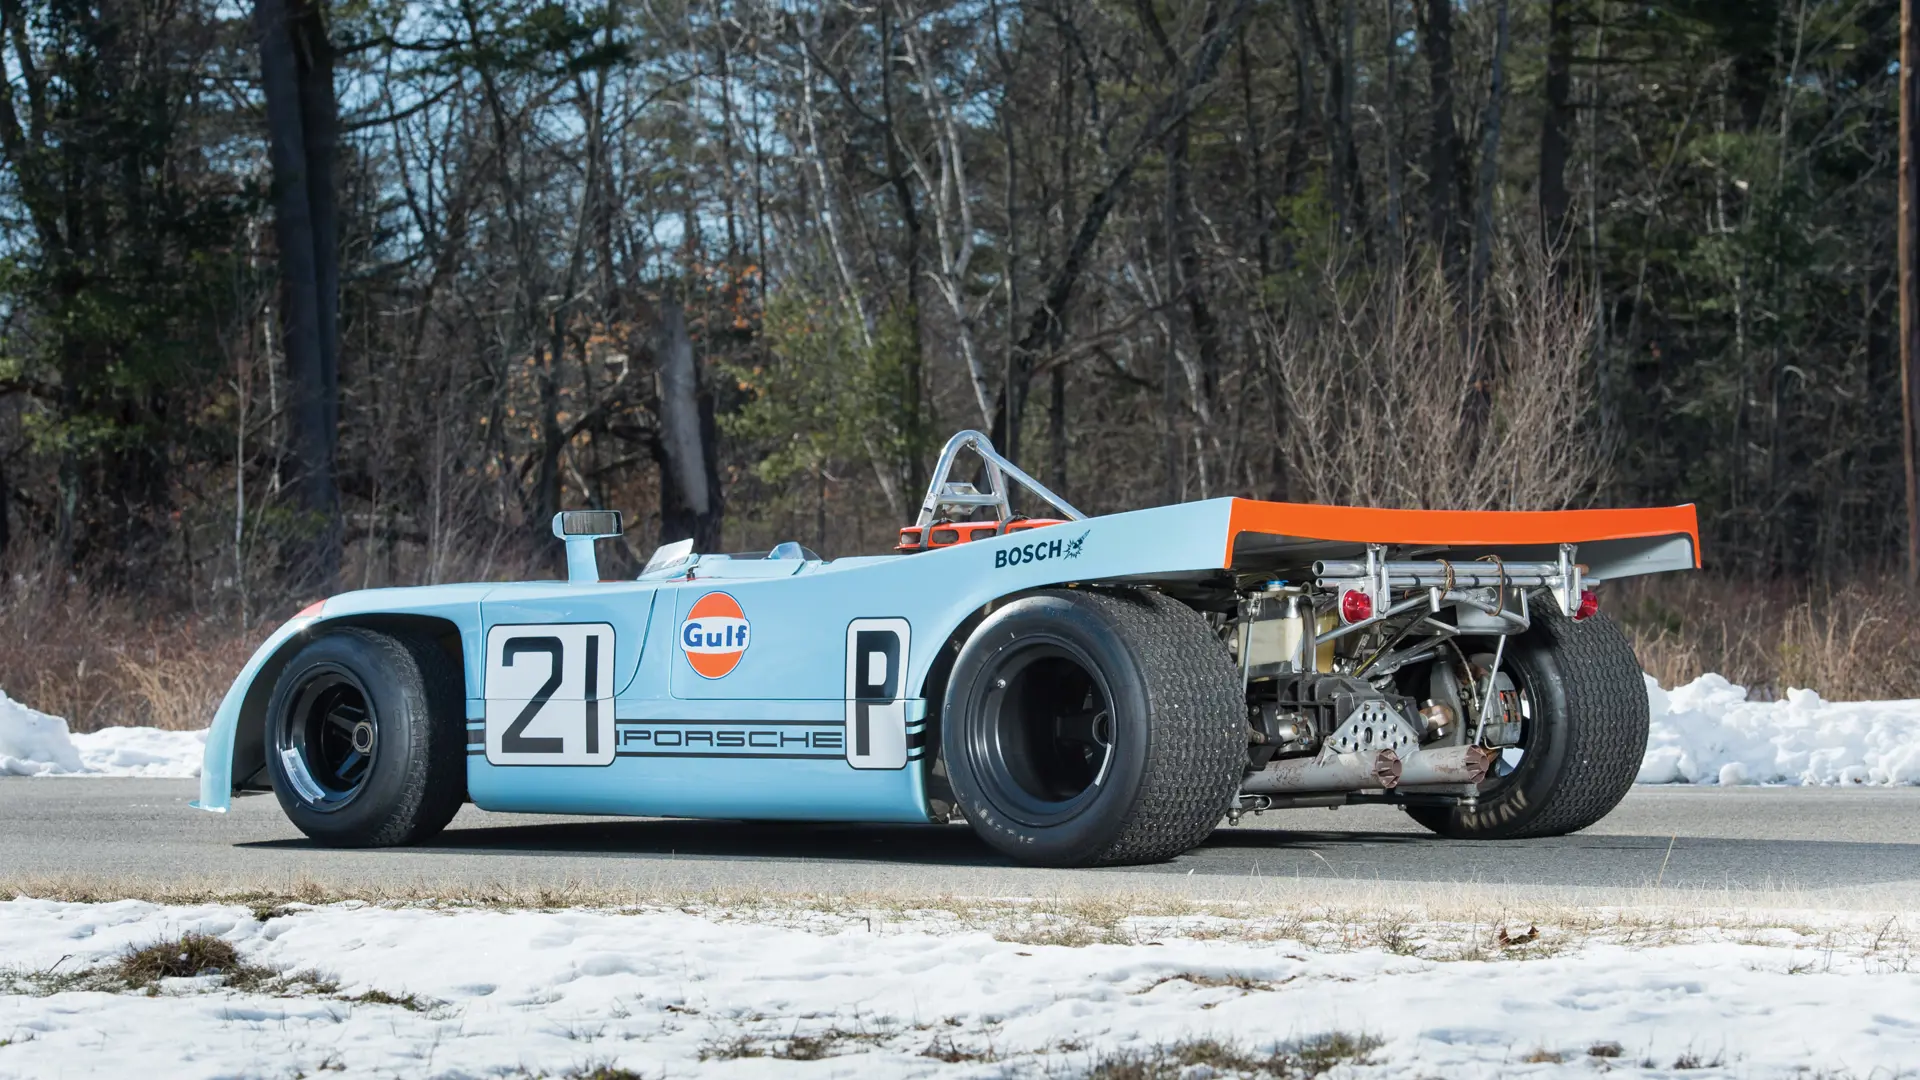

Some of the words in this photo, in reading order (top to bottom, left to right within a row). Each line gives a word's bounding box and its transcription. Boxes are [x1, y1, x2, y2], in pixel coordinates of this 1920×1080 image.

[995, 539, 1062, 568] BOSCH
[683, 622, 747, 647] Gulf
[502, 635, 599, 754] 21
[855, 630, 901, 756] P
[624, 730, 842, 748] PORSCHE
